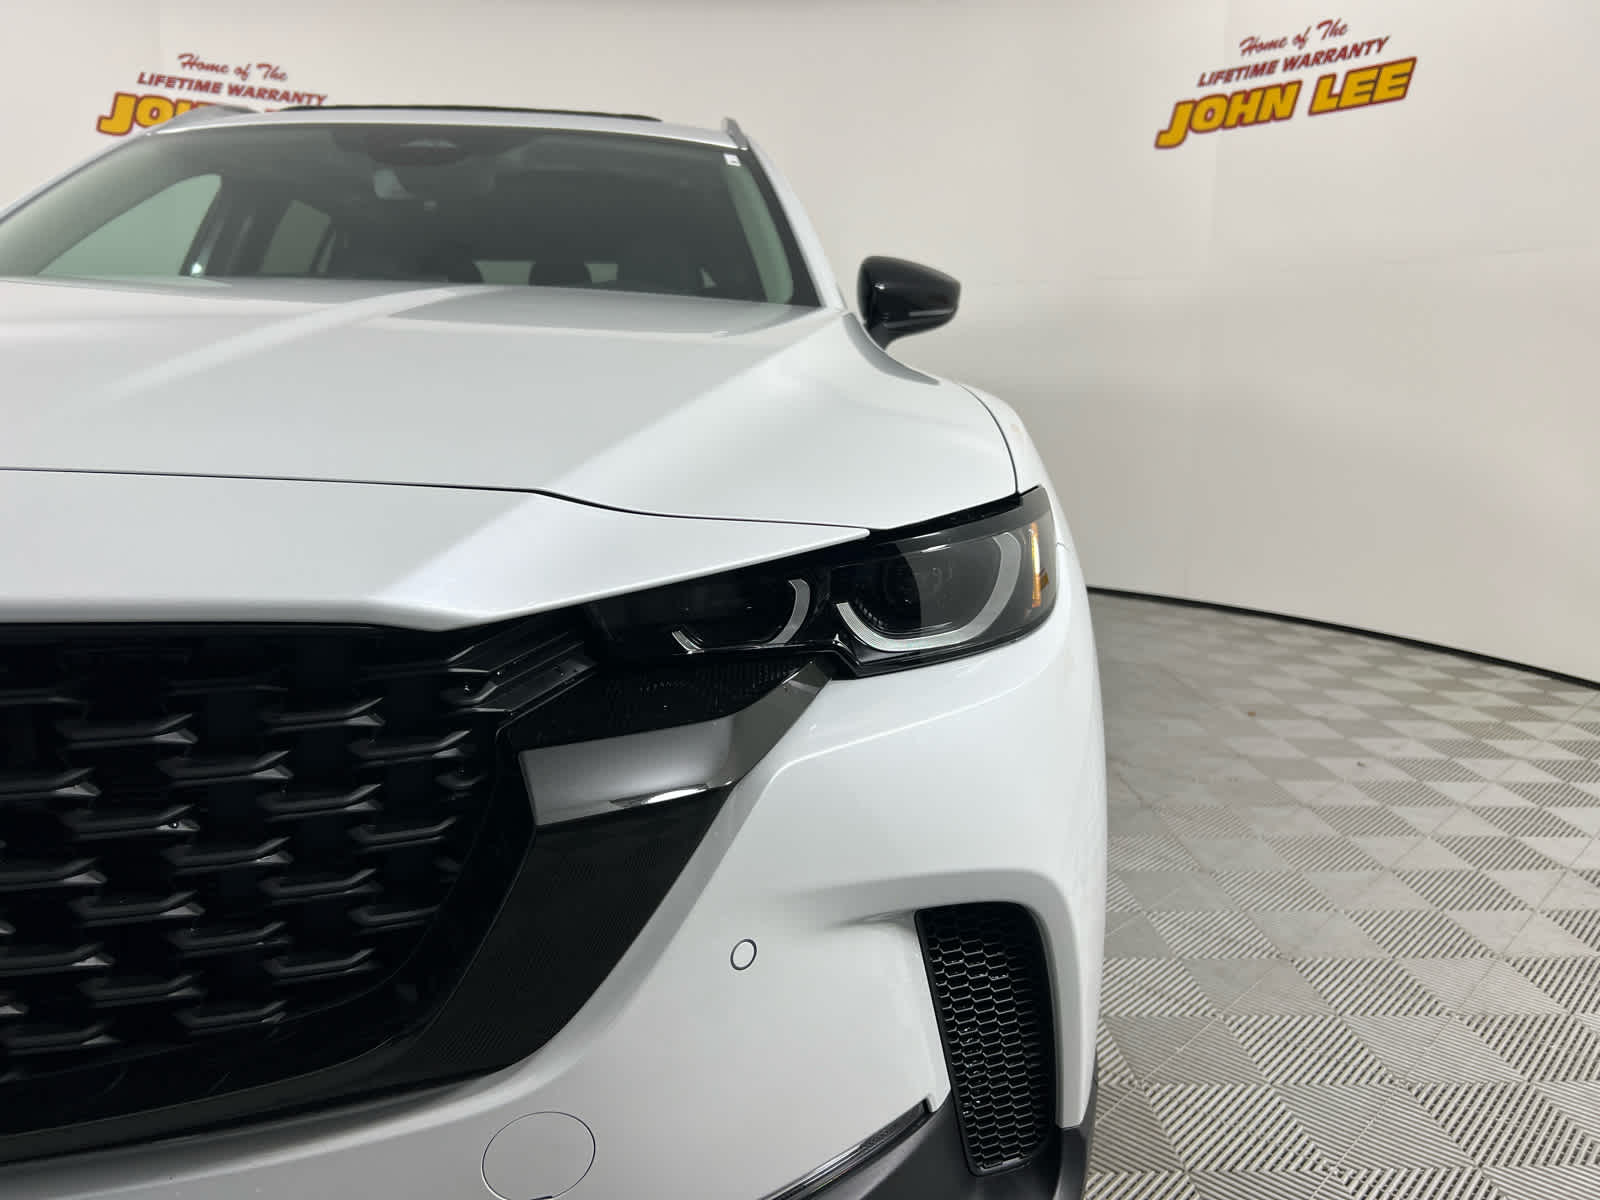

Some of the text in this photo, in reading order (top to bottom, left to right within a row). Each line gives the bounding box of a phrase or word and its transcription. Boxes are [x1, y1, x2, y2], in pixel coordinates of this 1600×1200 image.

[1239, 18, 1348, 56] Home of The
[178, 53, 288, 82] Home of The
[1197, 35, 1390, 87] LIFETIME WARRANTY
[137, 72, 328, 107] LIFETIME WARRANTY
[1154, 56, 1417, 149] JOHN LEE
